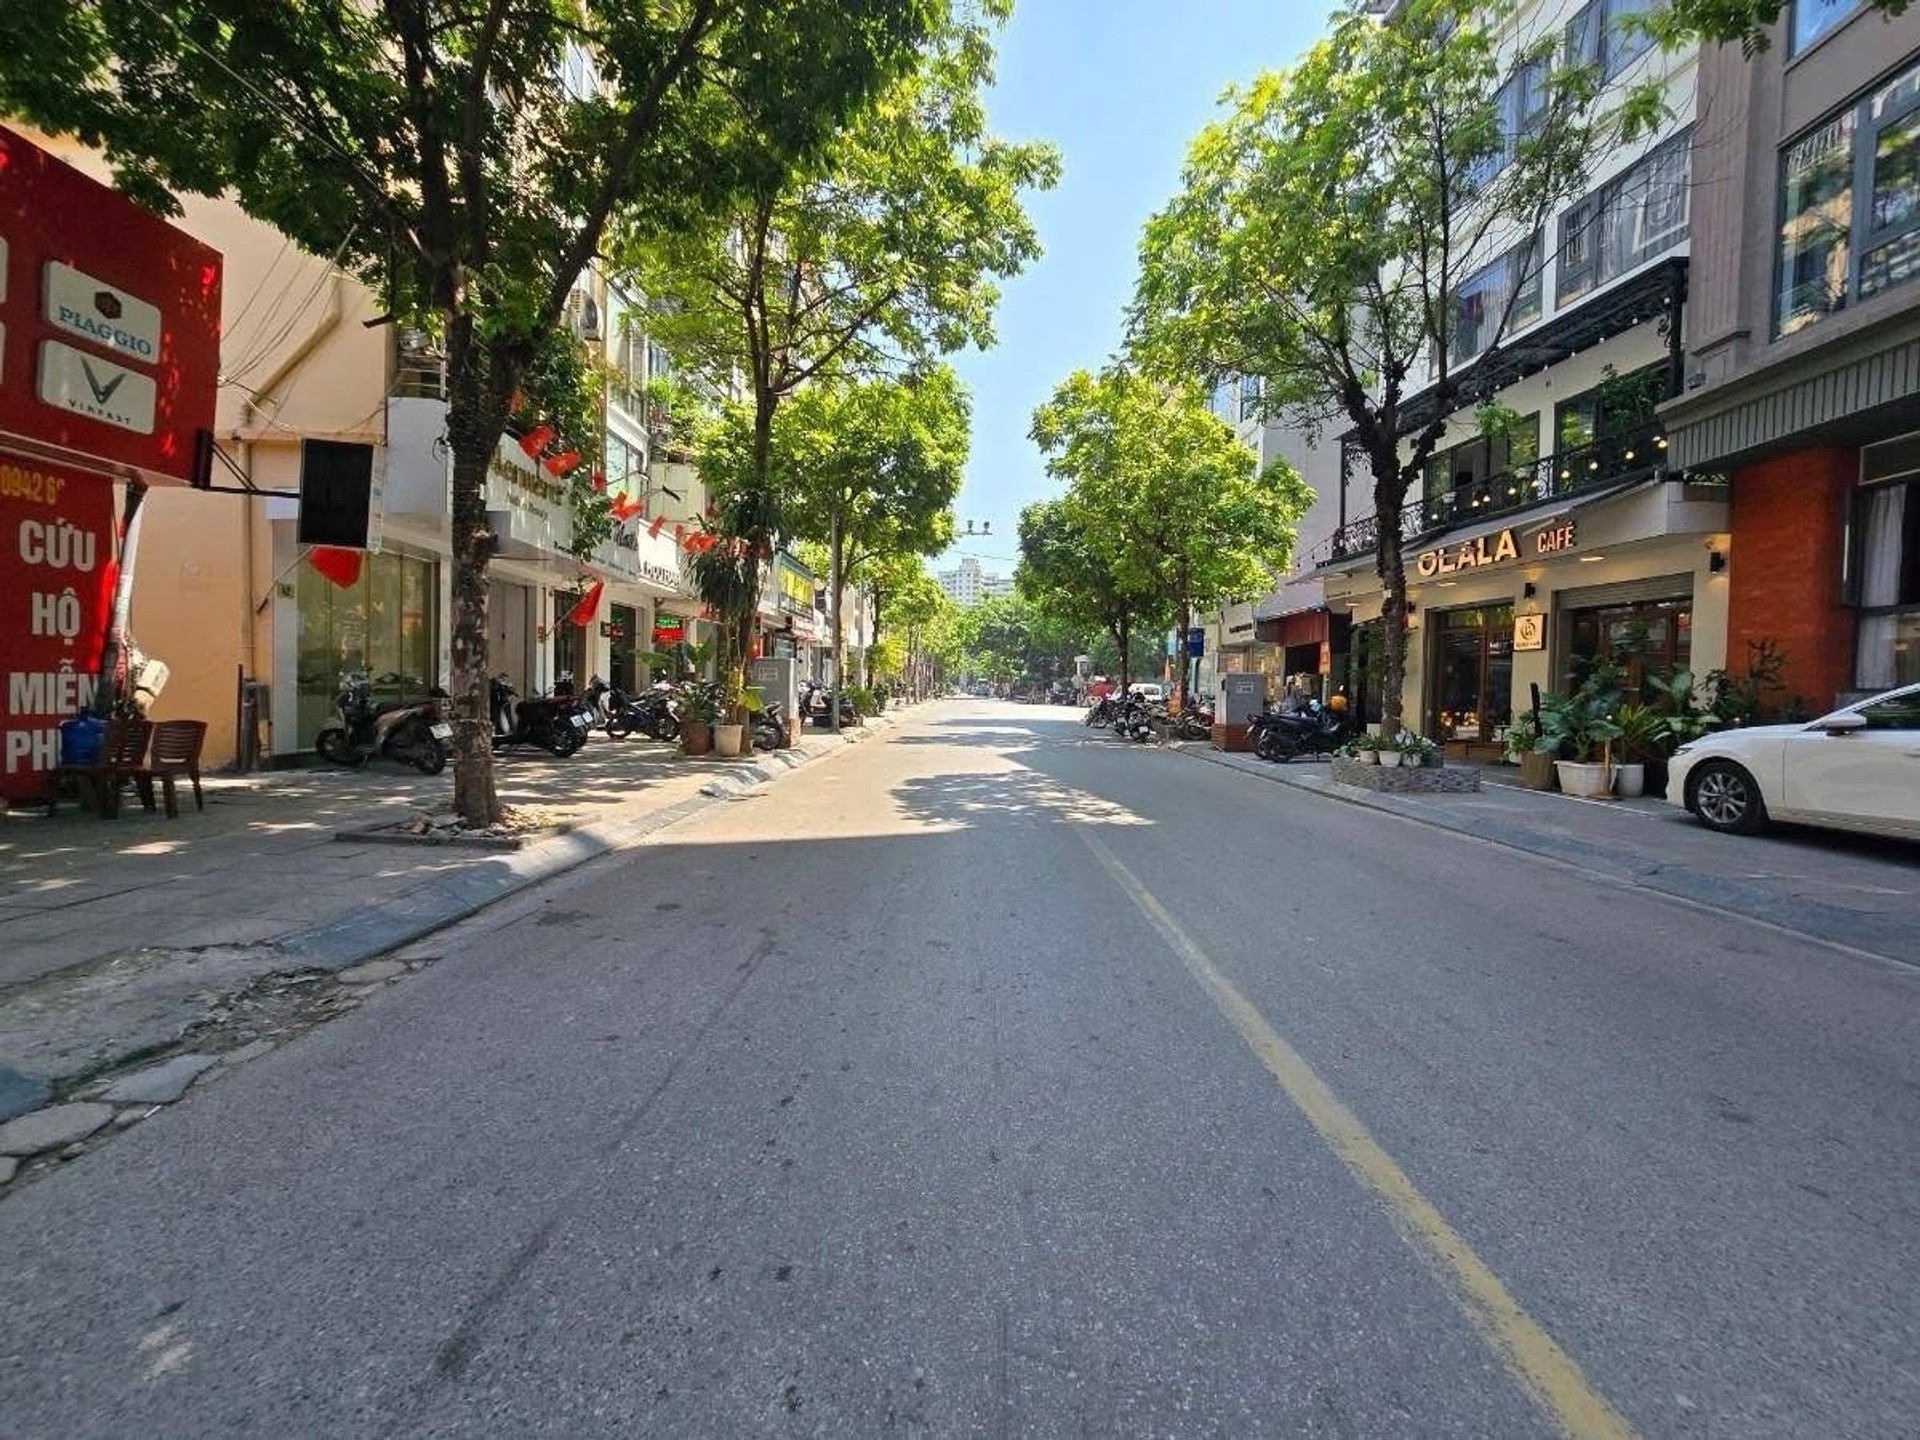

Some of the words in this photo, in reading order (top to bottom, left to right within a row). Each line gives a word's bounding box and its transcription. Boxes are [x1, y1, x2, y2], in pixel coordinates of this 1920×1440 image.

[58, 305, 153, 356] PIAGGIO
[68, 398, 131, 425] VINFAST
[20, 517, 96, 573] CỨU
[1537, 521, 1575, 554] CAFÉ
[32, 586, 81, 646] HỘ
[9, 658, 101, 716] MIỄN
